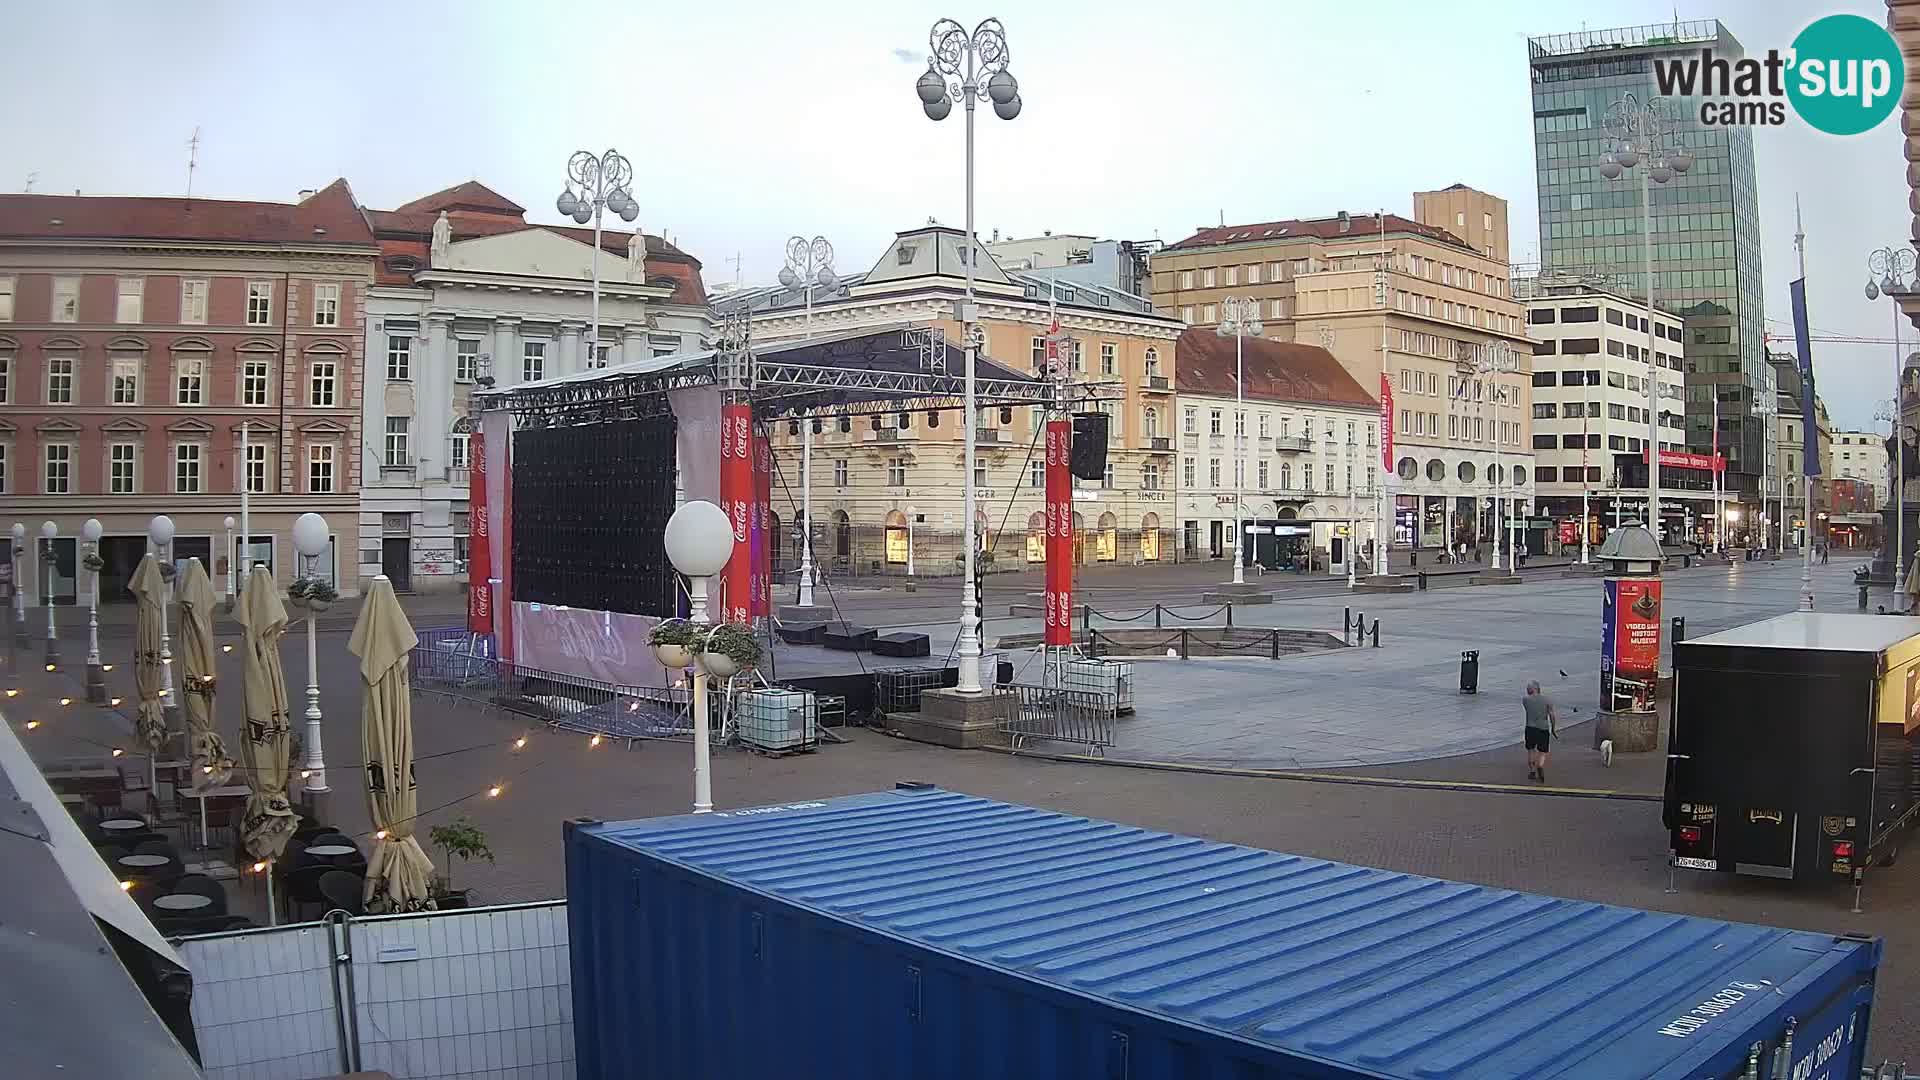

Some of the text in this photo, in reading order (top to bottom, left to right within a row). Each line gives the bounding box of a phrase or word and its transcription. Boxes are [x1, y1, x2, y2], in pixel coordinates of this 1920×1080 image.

[1137, 492, 1166, 501] SINGER
[1657, 1015, 1709, 1038] MCDU
[1690, 988, 1747, 1017] 300629
